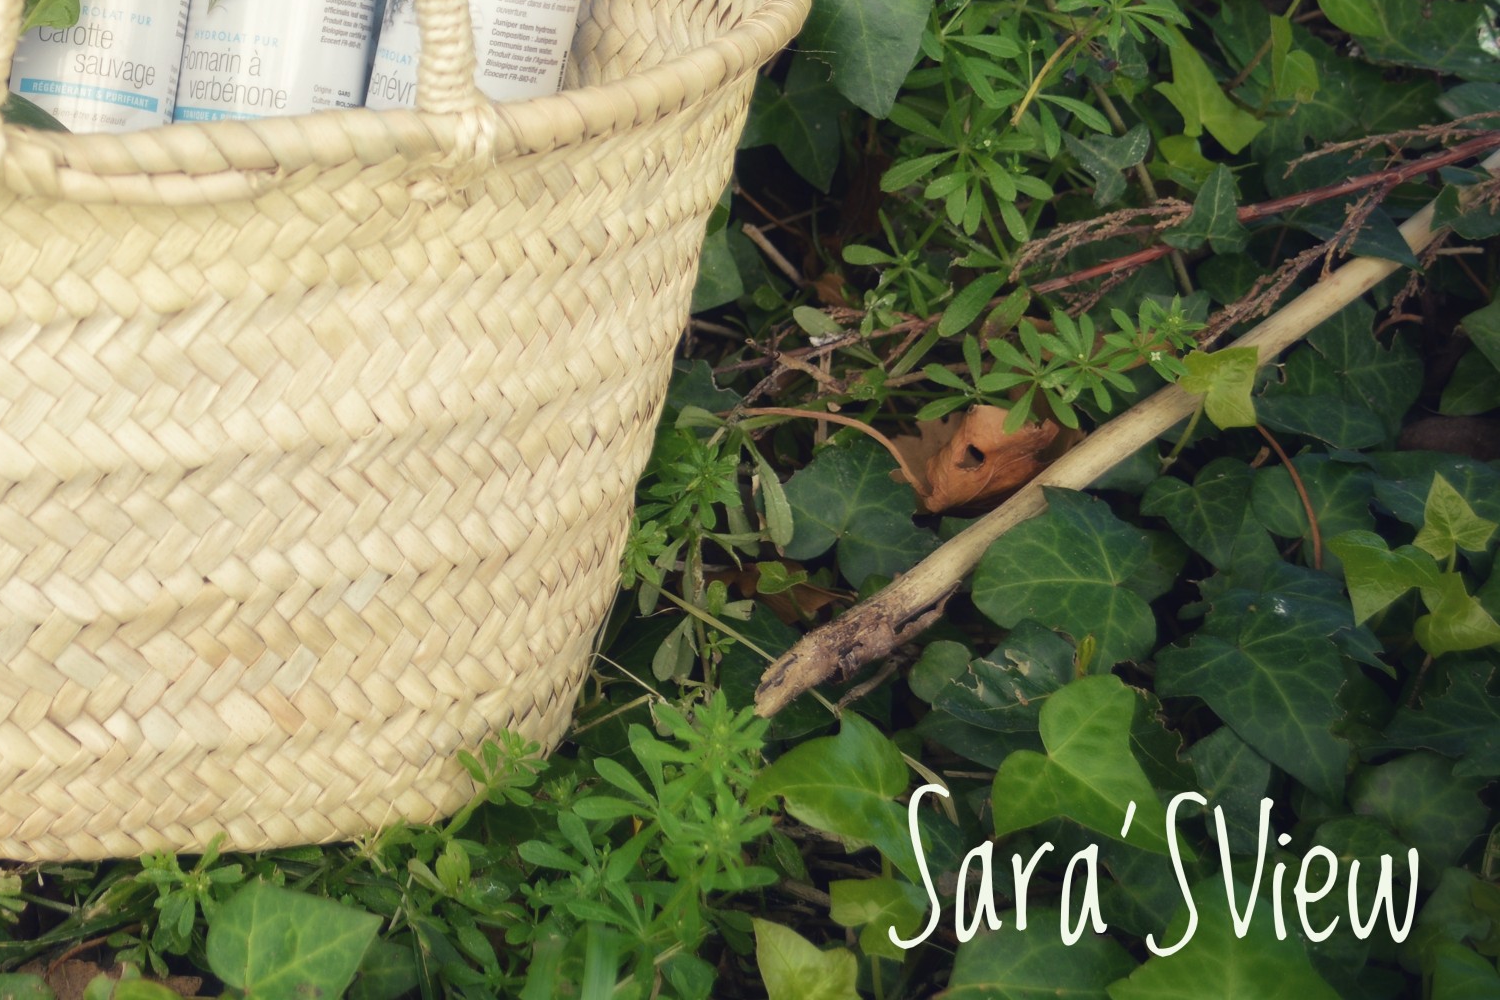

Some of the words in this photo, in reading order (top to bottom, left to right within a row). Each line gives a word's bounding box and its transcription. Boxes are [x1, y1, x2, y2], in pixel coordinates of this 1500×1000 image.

[82, 5, 124, 20] ROLAT
[131, 13, 152, 26] PUR
[492, 18, 519, 29] Juniper
[519, 22, 534, 31] stem
[38, 23, 113, 49] Carotte
[195, 29, 246, 43] HYDROLAT
[254, 35, 279, 47] PUR
[491, 28, 531, 41] Composition
[487, 48, 511, 60] Produit
[489, 39, 522, 51] communis
[523, 45, 538, 53] stem
[182, 44, 241, 74] Romarin
[248, 50, 261, 77] à
[485, 58, 519, 71] Biologique
[74, 53, 155, 89] sauvage
[483, 68, 508, 80] Ecocert
[189, 75, 288, 109] verbénone
[369, 64, 417, 106] enévr
[32, 81, 92, 97] RÉGÉNÉRANT
[106, 92, 149, 109] PURIFIANT
